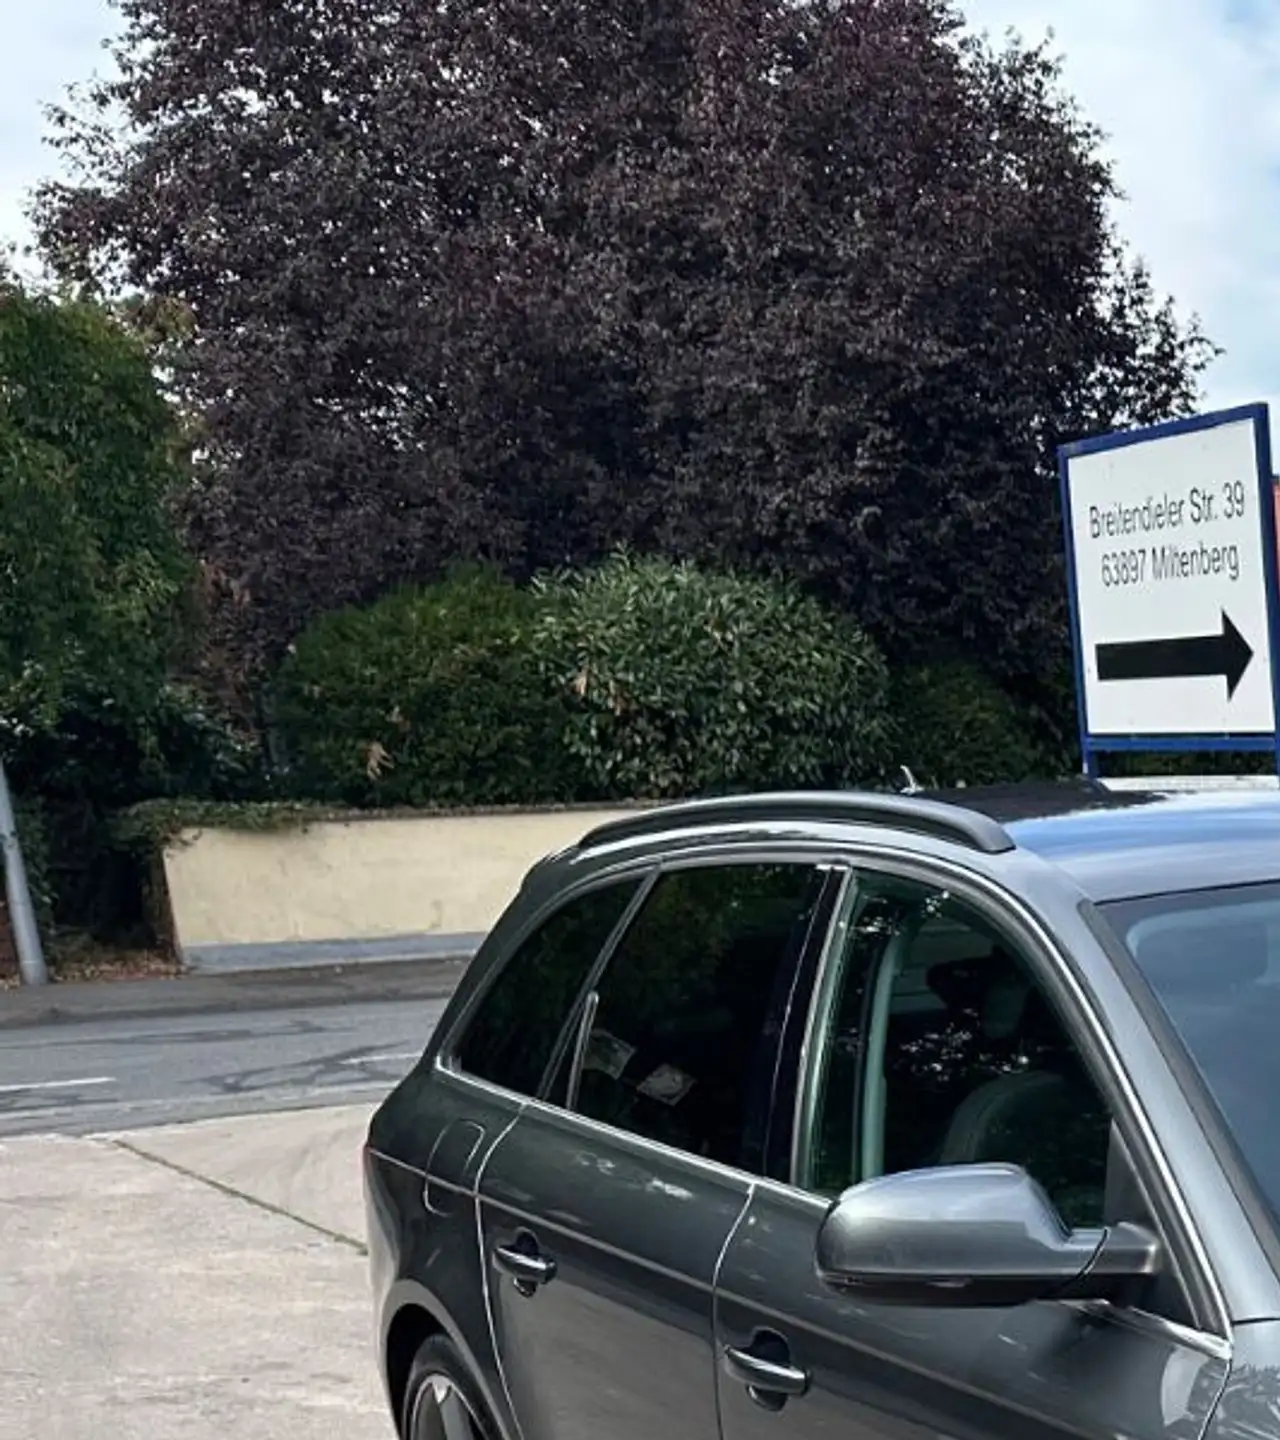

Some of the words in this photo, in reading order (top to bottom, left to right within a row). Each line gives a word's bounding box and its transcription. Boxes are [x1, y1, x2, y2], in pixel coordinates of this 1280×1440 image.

[1190, 486, 1218, 525] Str.
[1223, 480, 1245, 519] 39
[1101, 547, 1147, 587] 63897
[1151, 540, 1240, 581] Miltenberg
